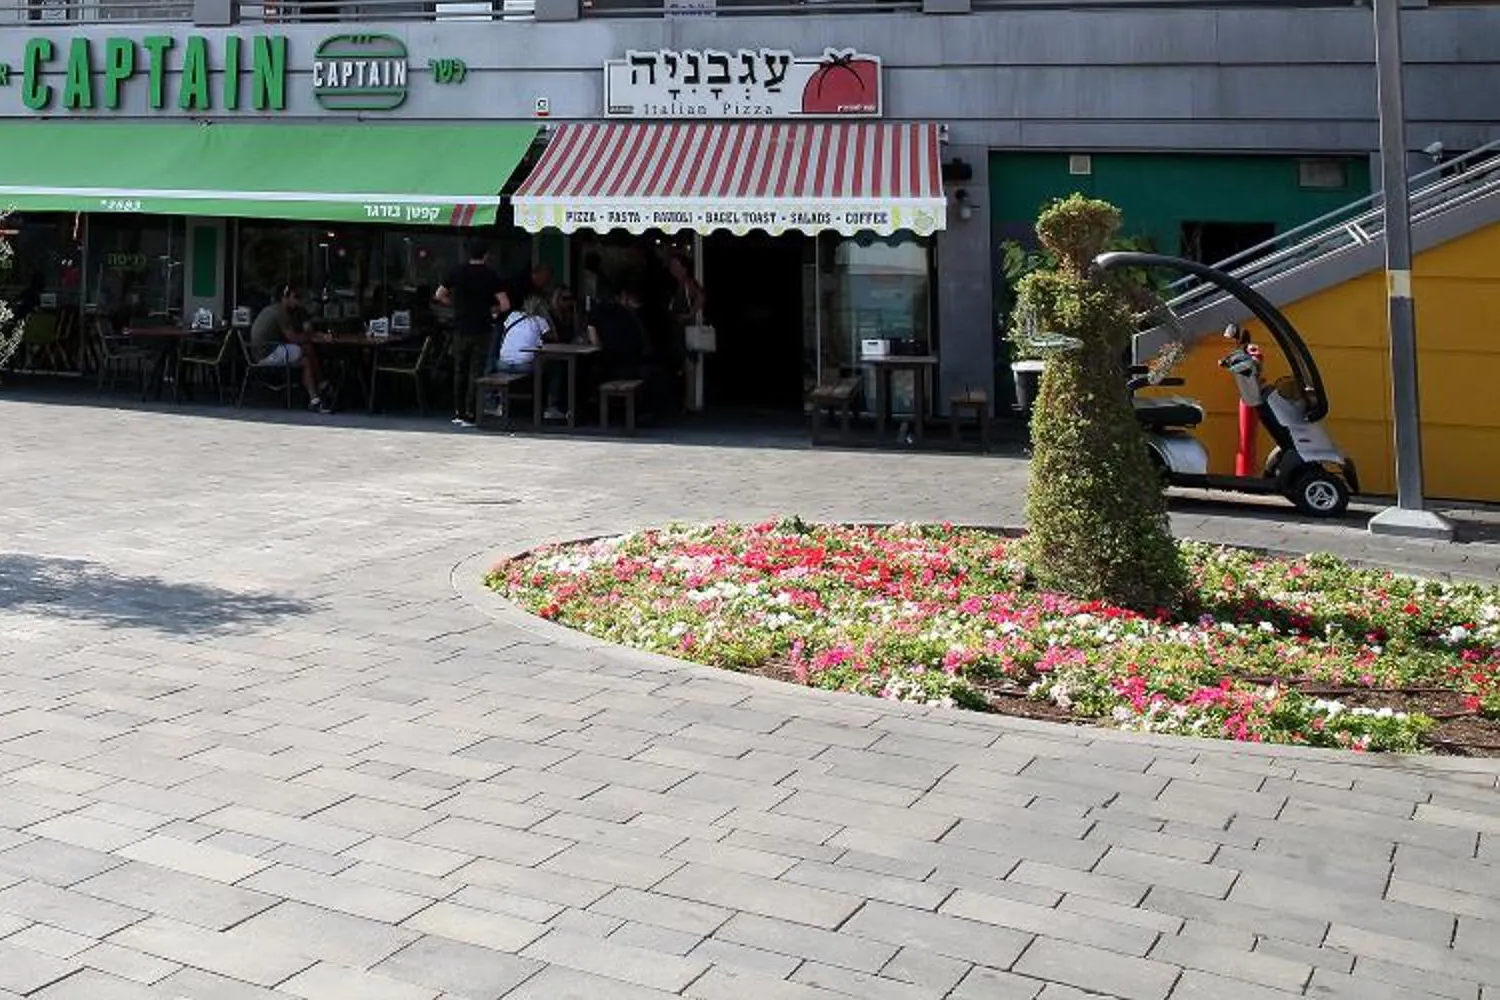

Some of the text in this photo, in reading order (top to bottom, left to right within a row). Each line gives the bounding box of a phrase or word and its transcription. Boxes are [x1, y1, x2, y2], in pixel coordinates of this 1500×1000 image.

[22, 34, 290, 111] CAPTAIN
[313, 59, 408, 88] CAPTAIN
[427, 57, 467, 85] כשר
[643, 102, 707, 116] Italian
[723, 102, 774, 116] Pizza
[363, 204, 441, 221] קפטן בורגר
[566, 211, 888, 224] PIZZA PASTA RAVIOLI BAGEL TOAST SALADS COFFEE
